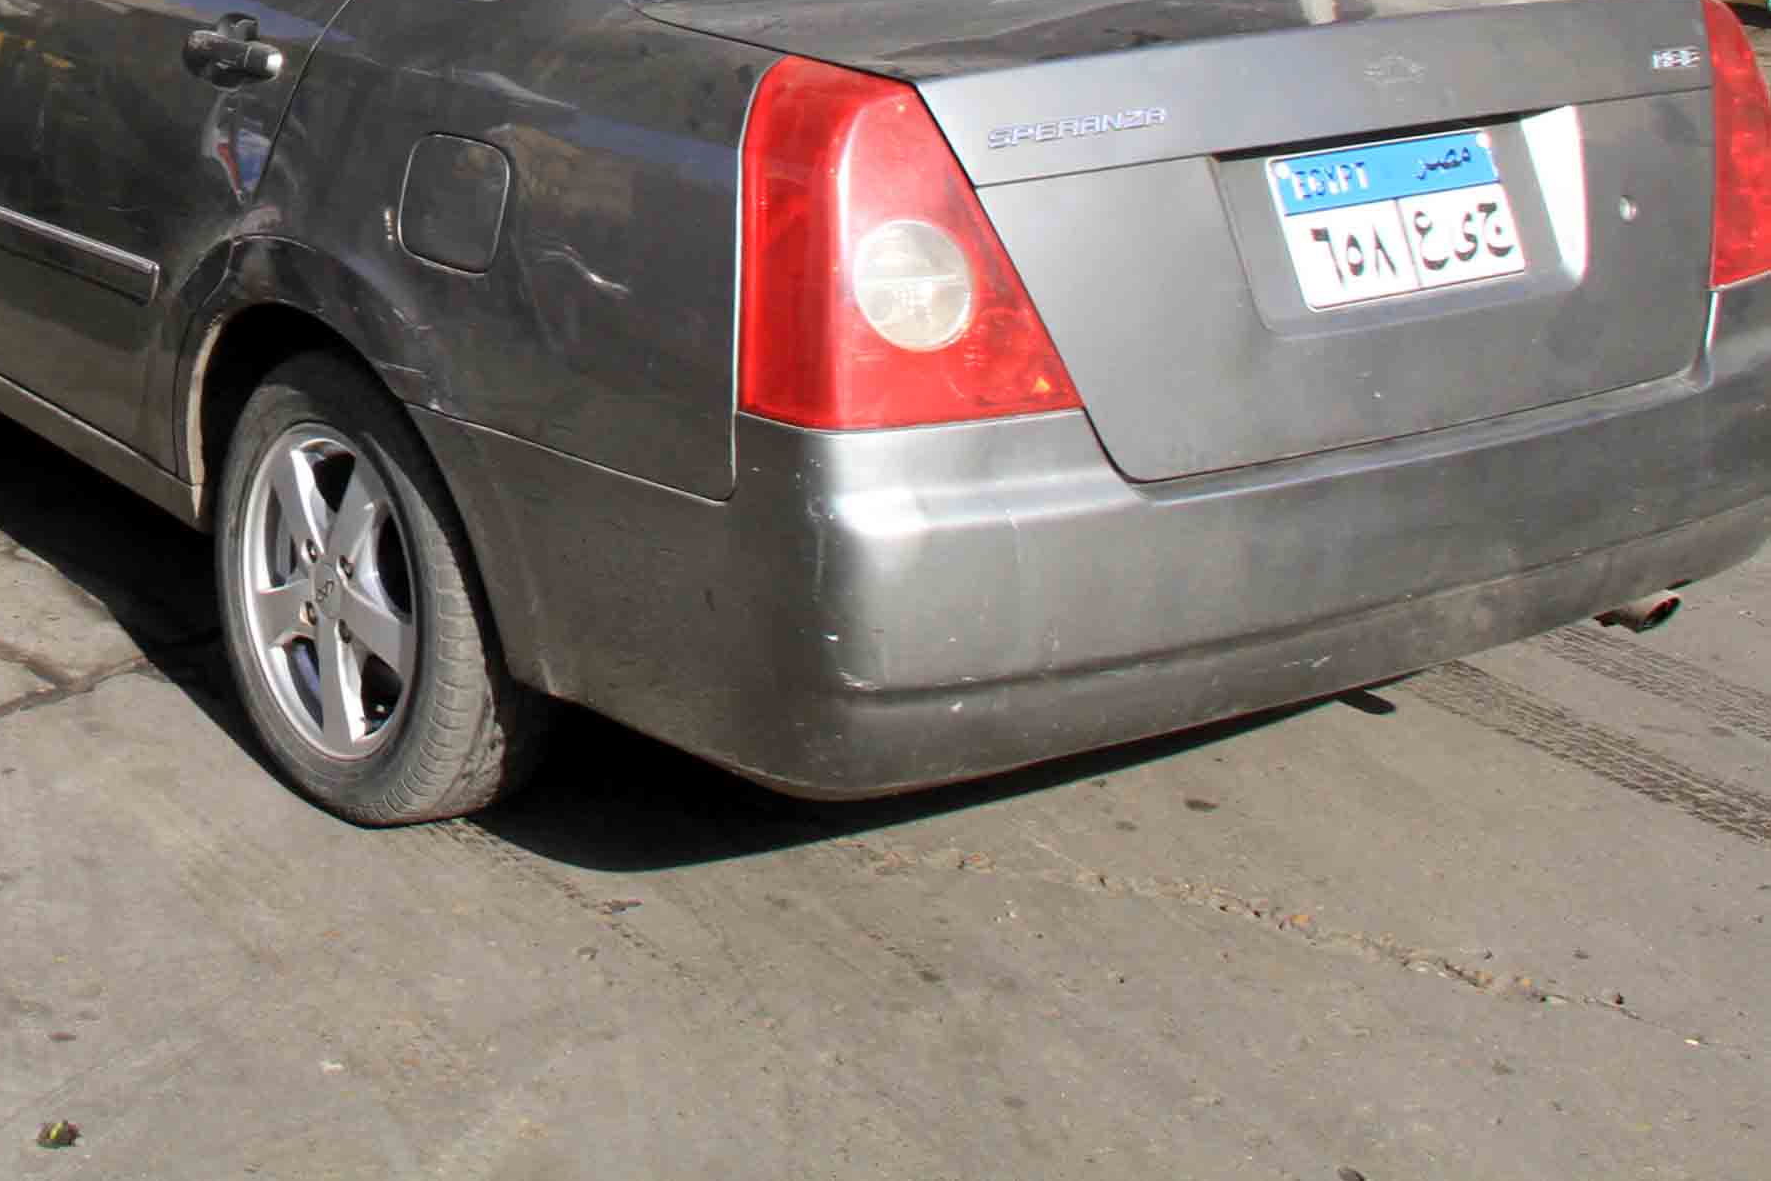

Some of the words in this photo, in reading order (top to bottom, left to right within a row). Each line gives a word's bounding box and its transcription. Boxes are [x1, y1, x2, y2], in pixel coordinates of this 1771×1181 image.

[987, 107, 1167, 149] SPERANZA
[1292, 161, 1369, 200] EGYPT
[1415, 146, 1472, 180] مصر
[1309, 225, 1399, 290] ٦٥٨
